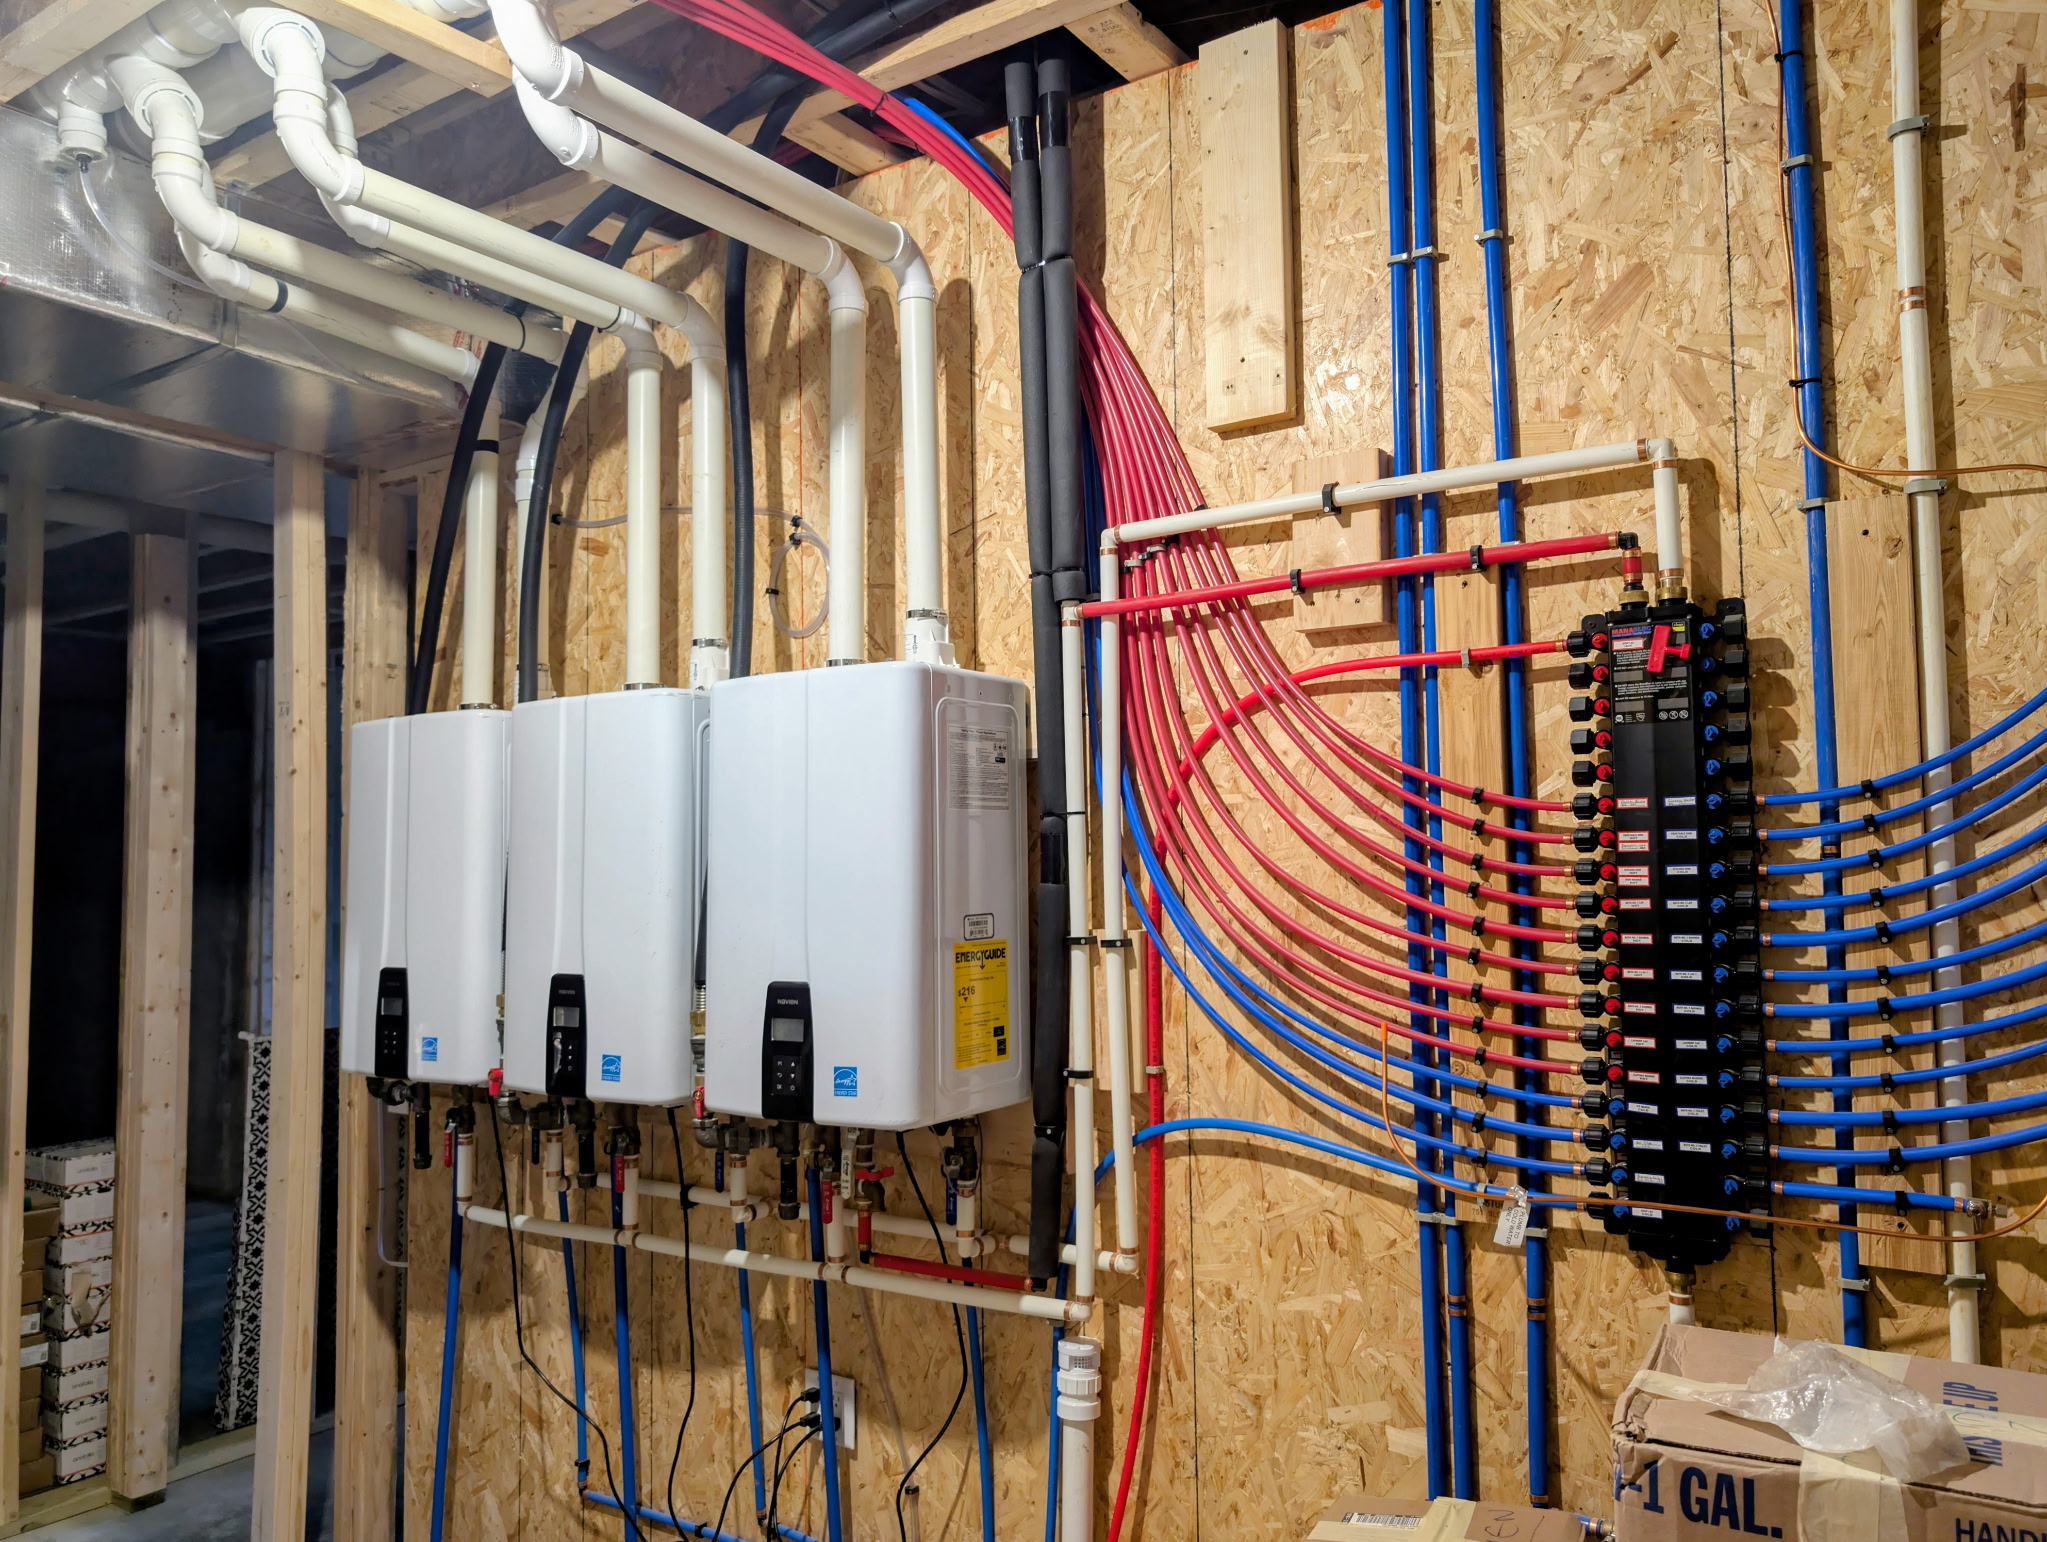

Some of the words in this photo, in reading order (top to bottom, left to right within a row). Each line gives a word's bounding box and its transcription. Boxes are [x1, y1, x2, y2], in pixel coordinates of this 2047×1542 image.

[1505, 1207, 1513, 1222] ONLY
[1510, 1209, 1519, 1225] COLD
[1515, 1211, 1525, 1231] PLUMB
[1505, 1225, 1515, 1245] WATER
[1513, 1230, 1520, 1239] TO
[1943, 1382, 1999, 1402] UP
[1680, 1466, 1783, 1539] GAL.
